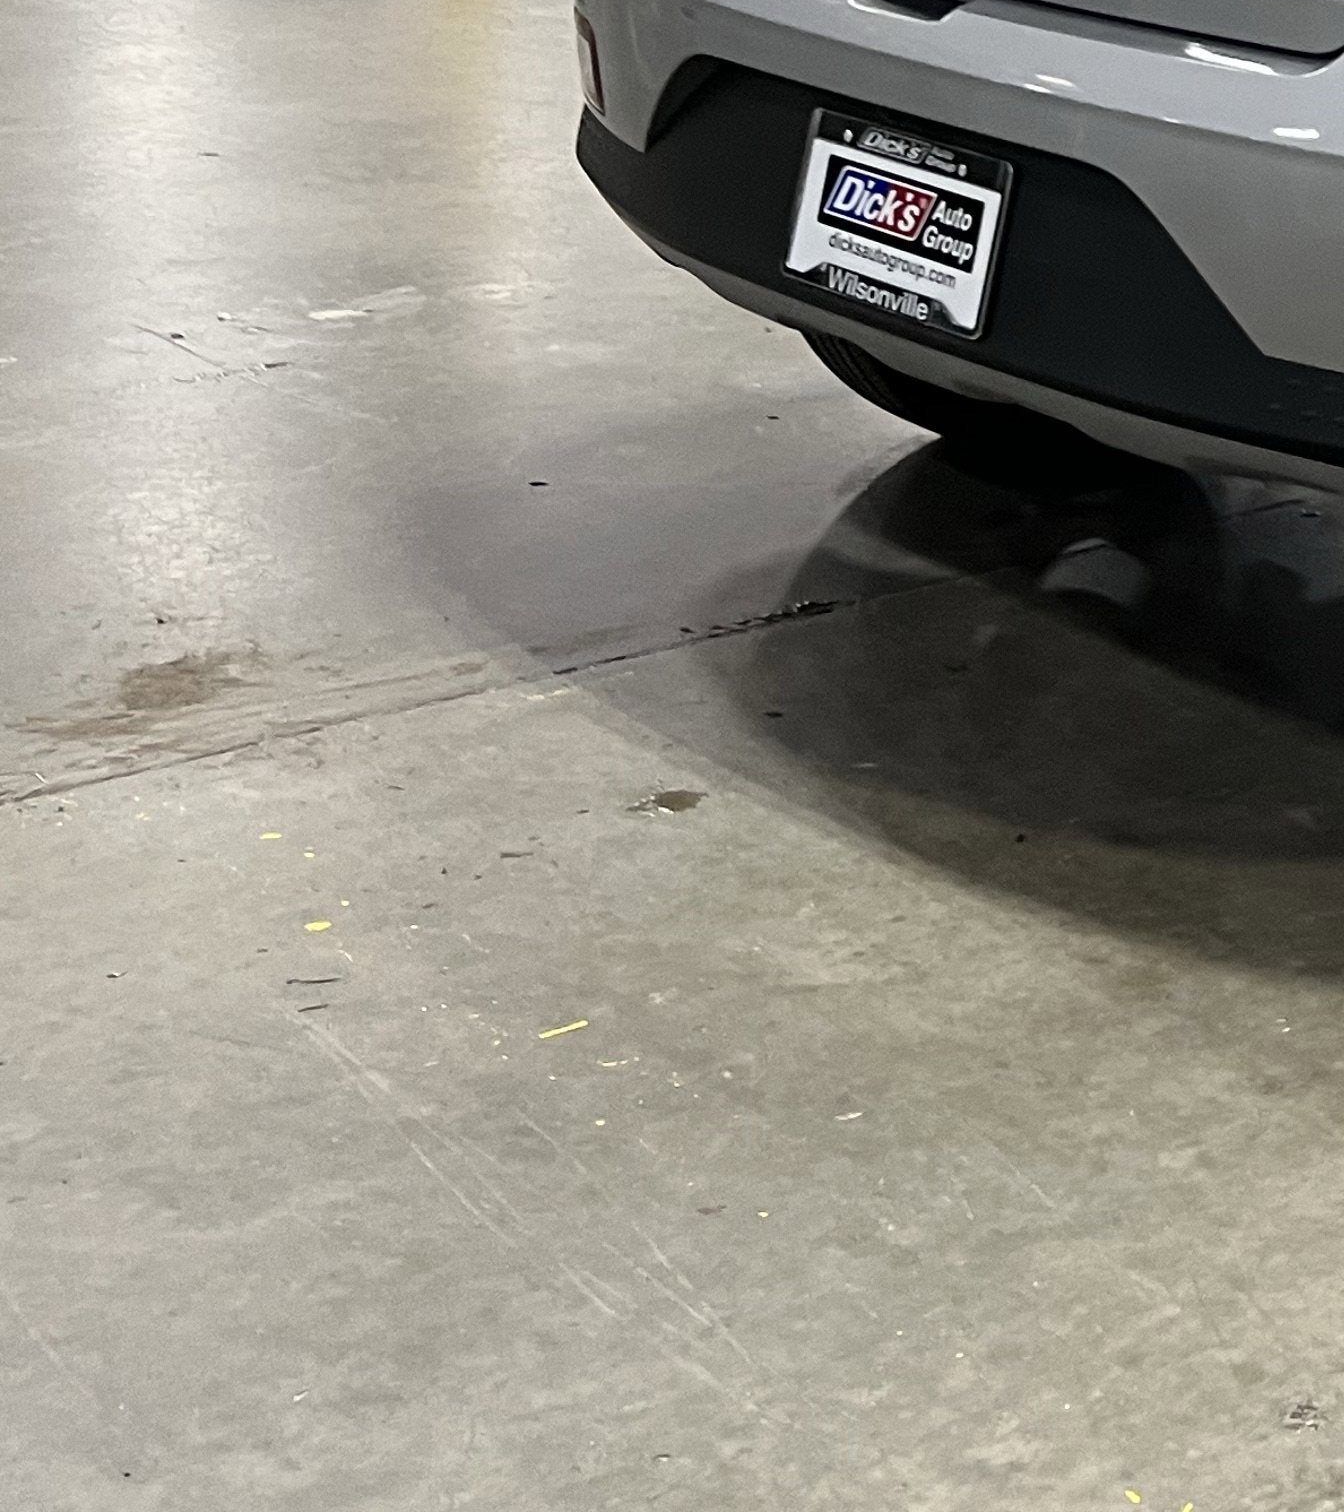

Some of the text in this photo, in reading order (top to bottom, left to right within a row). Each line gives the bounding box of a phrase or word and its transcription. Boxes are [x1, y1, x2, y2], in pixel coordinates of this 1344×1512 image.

[832, 175, 922, 233] Dick's
[930, 200, 973, 232] Auto
[827, 231, 957, 289] dicksautogroup.com
[921, 225, 975, 264] Group
[825, 265, 930, 321] Wilsonville
